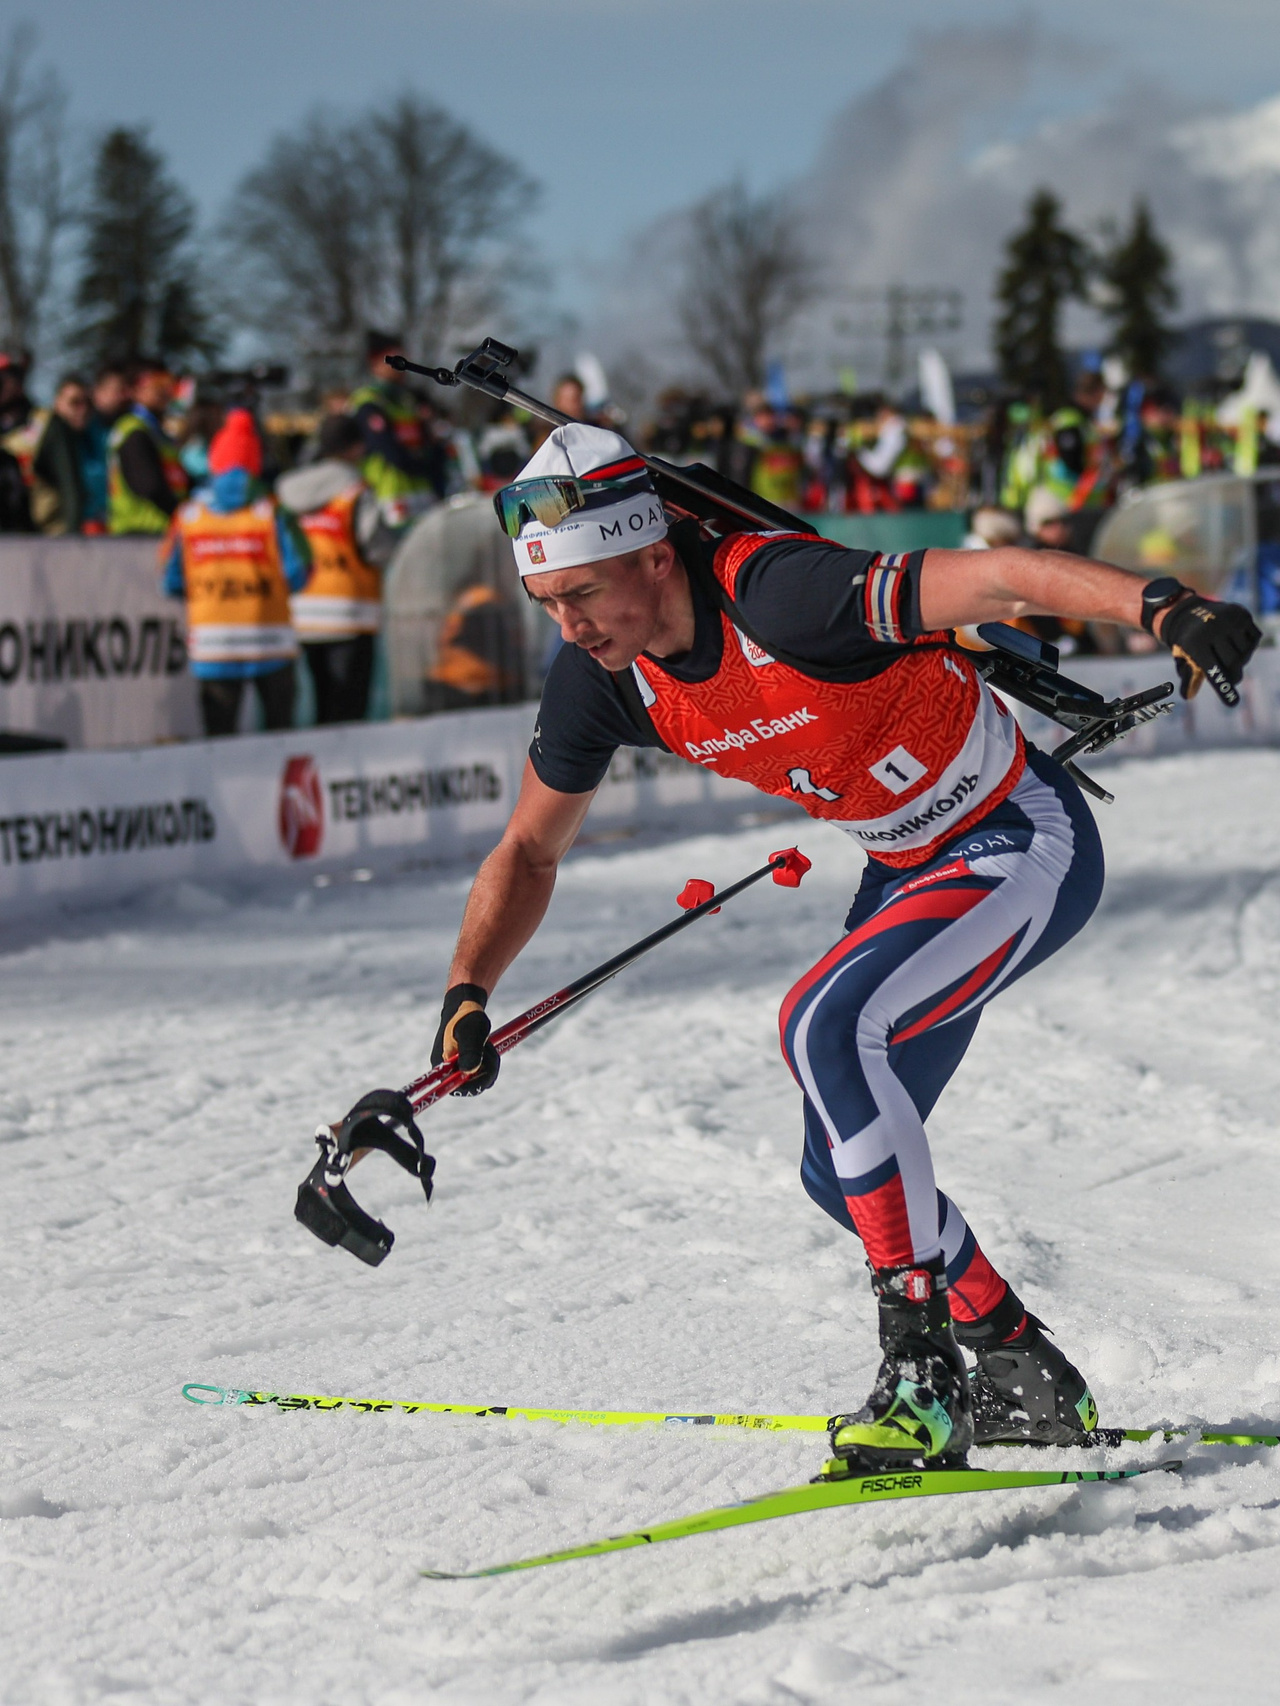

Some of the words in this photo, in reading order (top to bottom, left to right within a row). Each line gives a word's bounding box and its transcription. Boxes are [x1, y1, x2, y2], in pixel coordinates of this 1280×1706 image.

[1207, 665, 1237, 703] MOAX
[685, 729, 759, 763] Альфа
[750, 706, 819, 740] Банк
[884, 761, 910, 783] 1
[329, 764, 503, 823] ТЕХНОНИКОЛЬ
[0, 796, 216, 865] ТЕХНОНИКОЛЬ
[525, 995, 560, 1020] MOAX
[495, 1032, 522, 1053] MOAX
[860, 1475, 923, 1494] FISCHER
